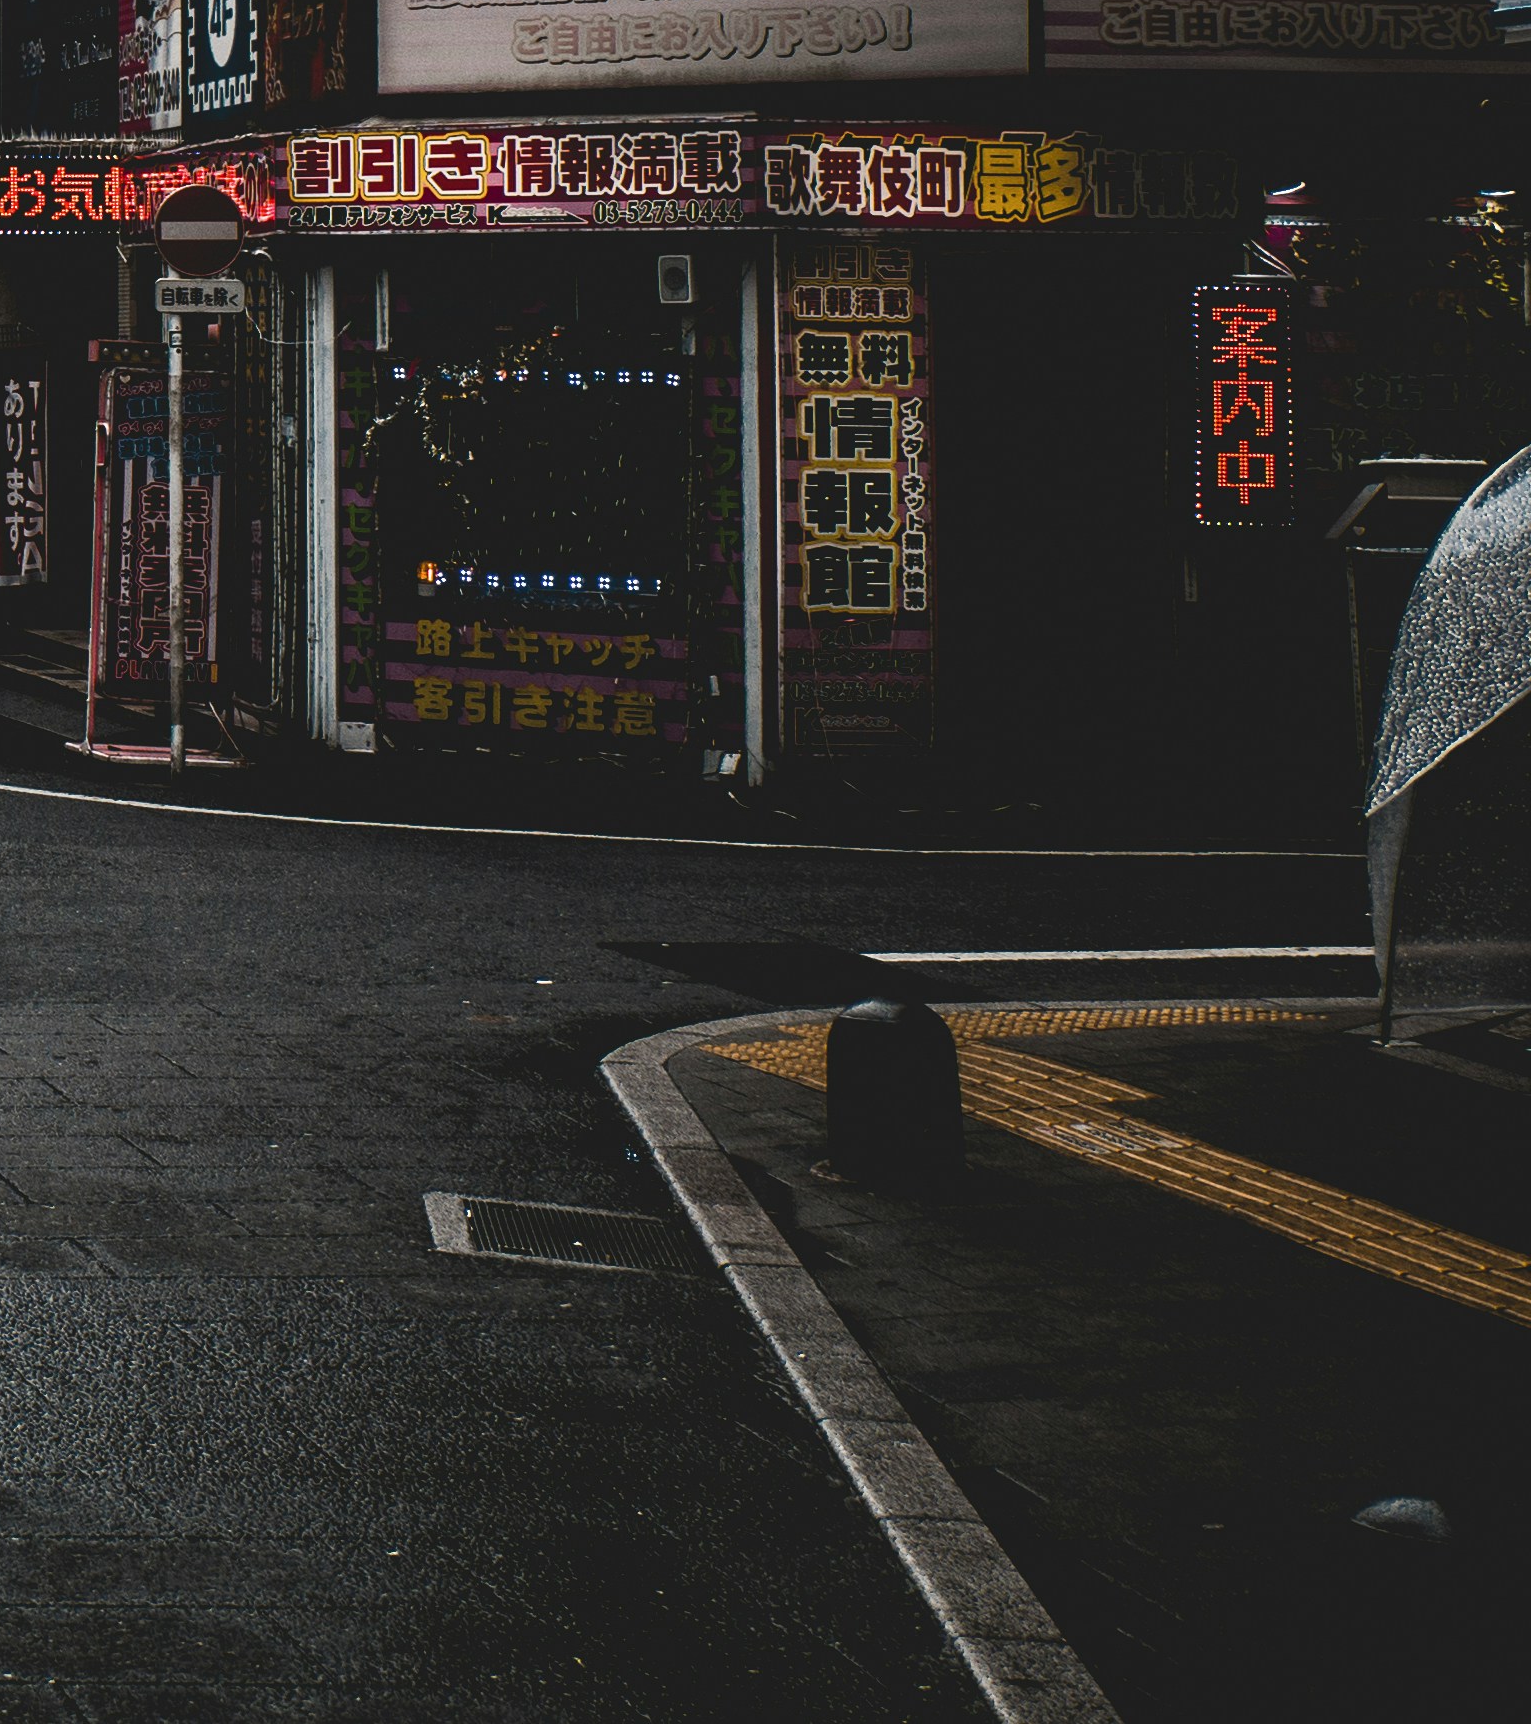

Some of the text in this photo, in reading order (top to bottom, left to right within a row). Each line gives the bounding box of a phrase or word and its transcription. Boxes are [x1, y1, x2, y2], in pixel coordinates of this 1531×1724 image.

[592, 198, 744, 225] 03-5273-0444
[160, 285, 239, 308] 自転車を除く
[792, 282, 914, 321] 情報満載
[794, 329, 918, 388] 無料
[1211, 303, 1278, 505] 案内中
[3, 378, 28, 555] あります
[797, 391, 901, 615] 情報館
[414, 617, 656, 670] 路上キャッチ
[413, 675, 659, 736] 客引き注意
